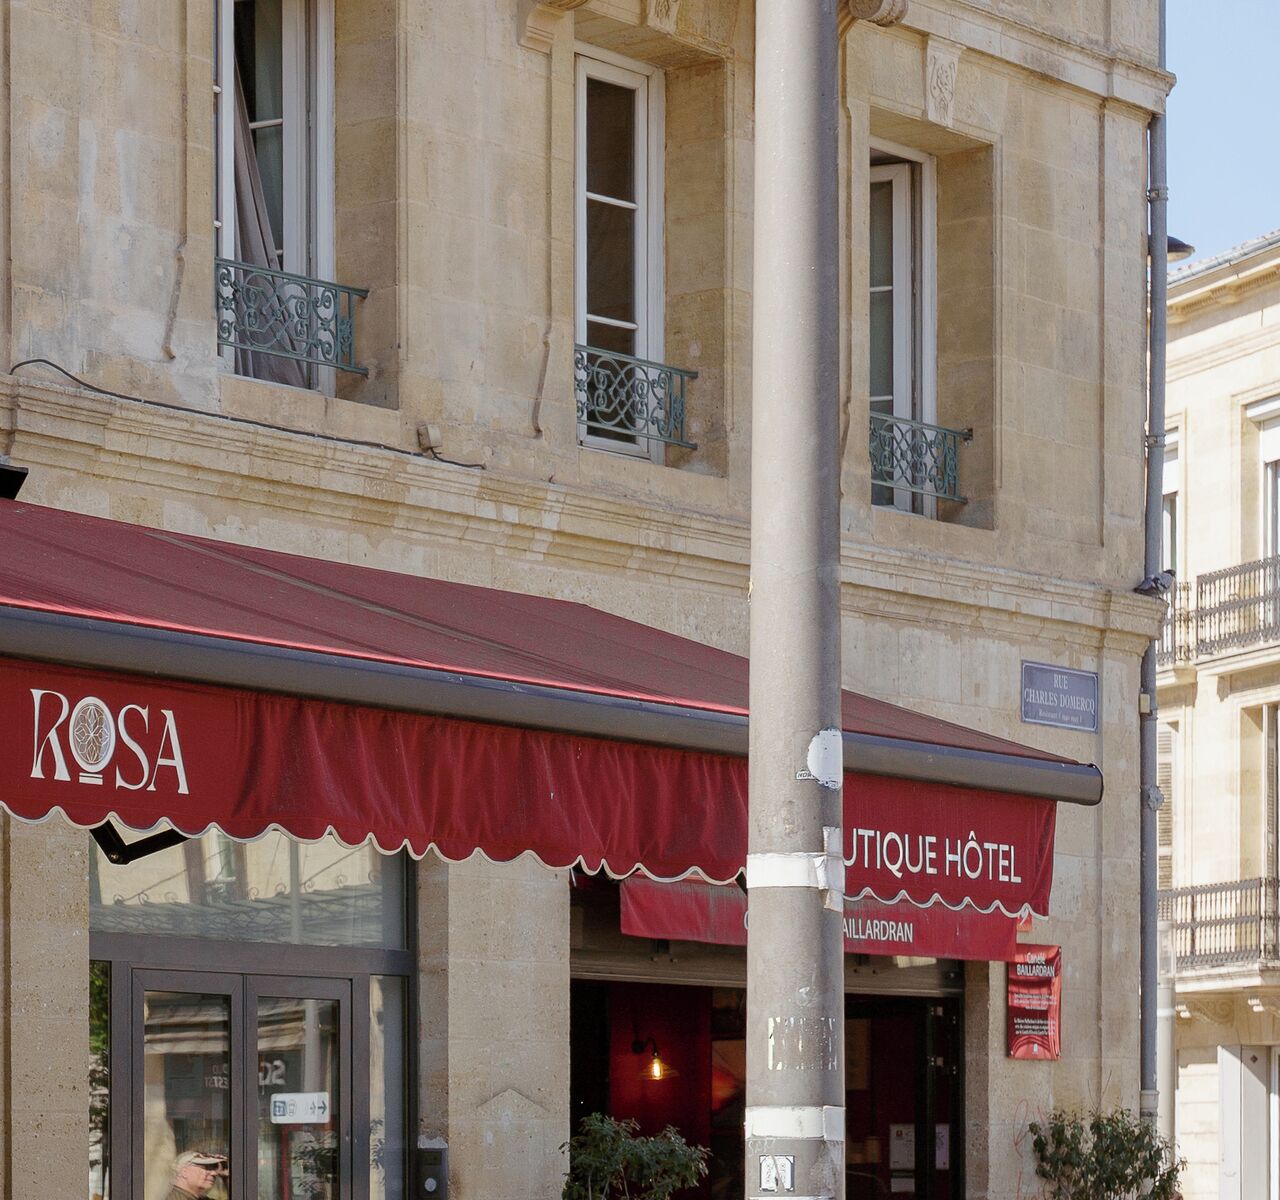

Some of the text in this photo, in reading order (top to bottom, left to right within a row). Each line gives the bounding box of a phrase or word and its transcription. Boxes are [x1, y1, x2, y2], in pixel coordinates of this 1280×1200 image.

[1053, 673, 1069, 690] RUE
[1024, 687, 1095, 716] CHARLES DOMERCQ
[29, 688, 190, 795] ROSA
[842, 828, 1022, 884] UTIQUE HÔTEL
[842, 919, 914, 943] AILLARDRAN
